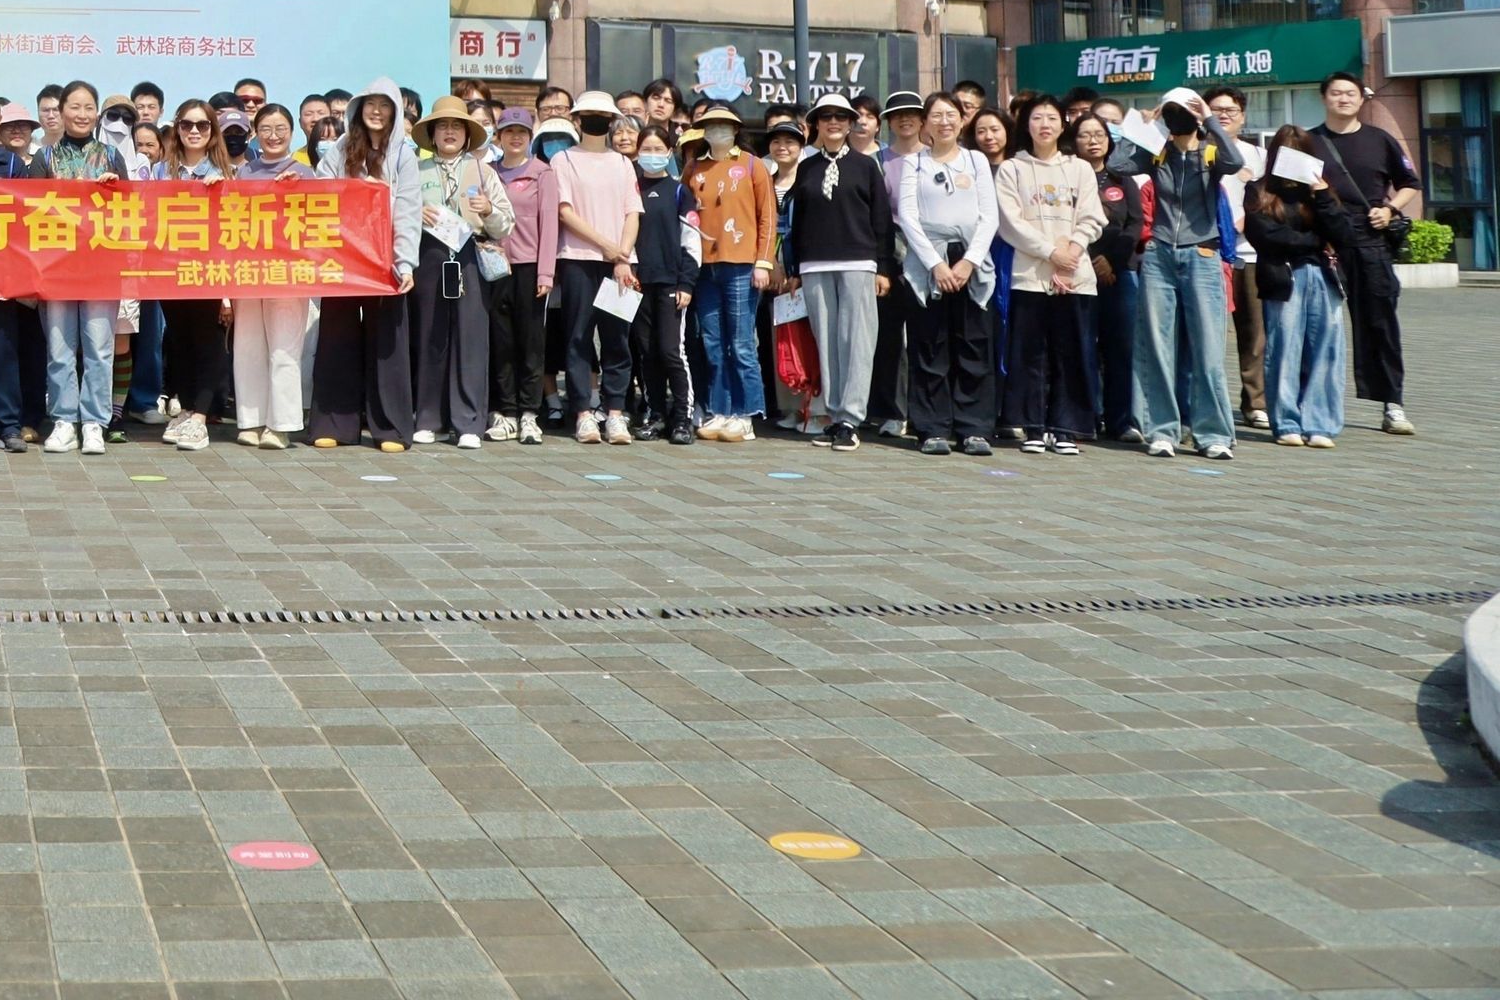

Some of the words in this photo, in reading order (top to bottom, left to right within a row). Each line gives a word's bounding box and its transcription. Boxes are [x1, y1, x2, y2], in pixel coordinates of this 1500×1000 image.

[459, 31, 521, 58] 商行
[1077, 45, 1161, 84] 新东方
[1186, 49, 1273, 79] 斯林姆
